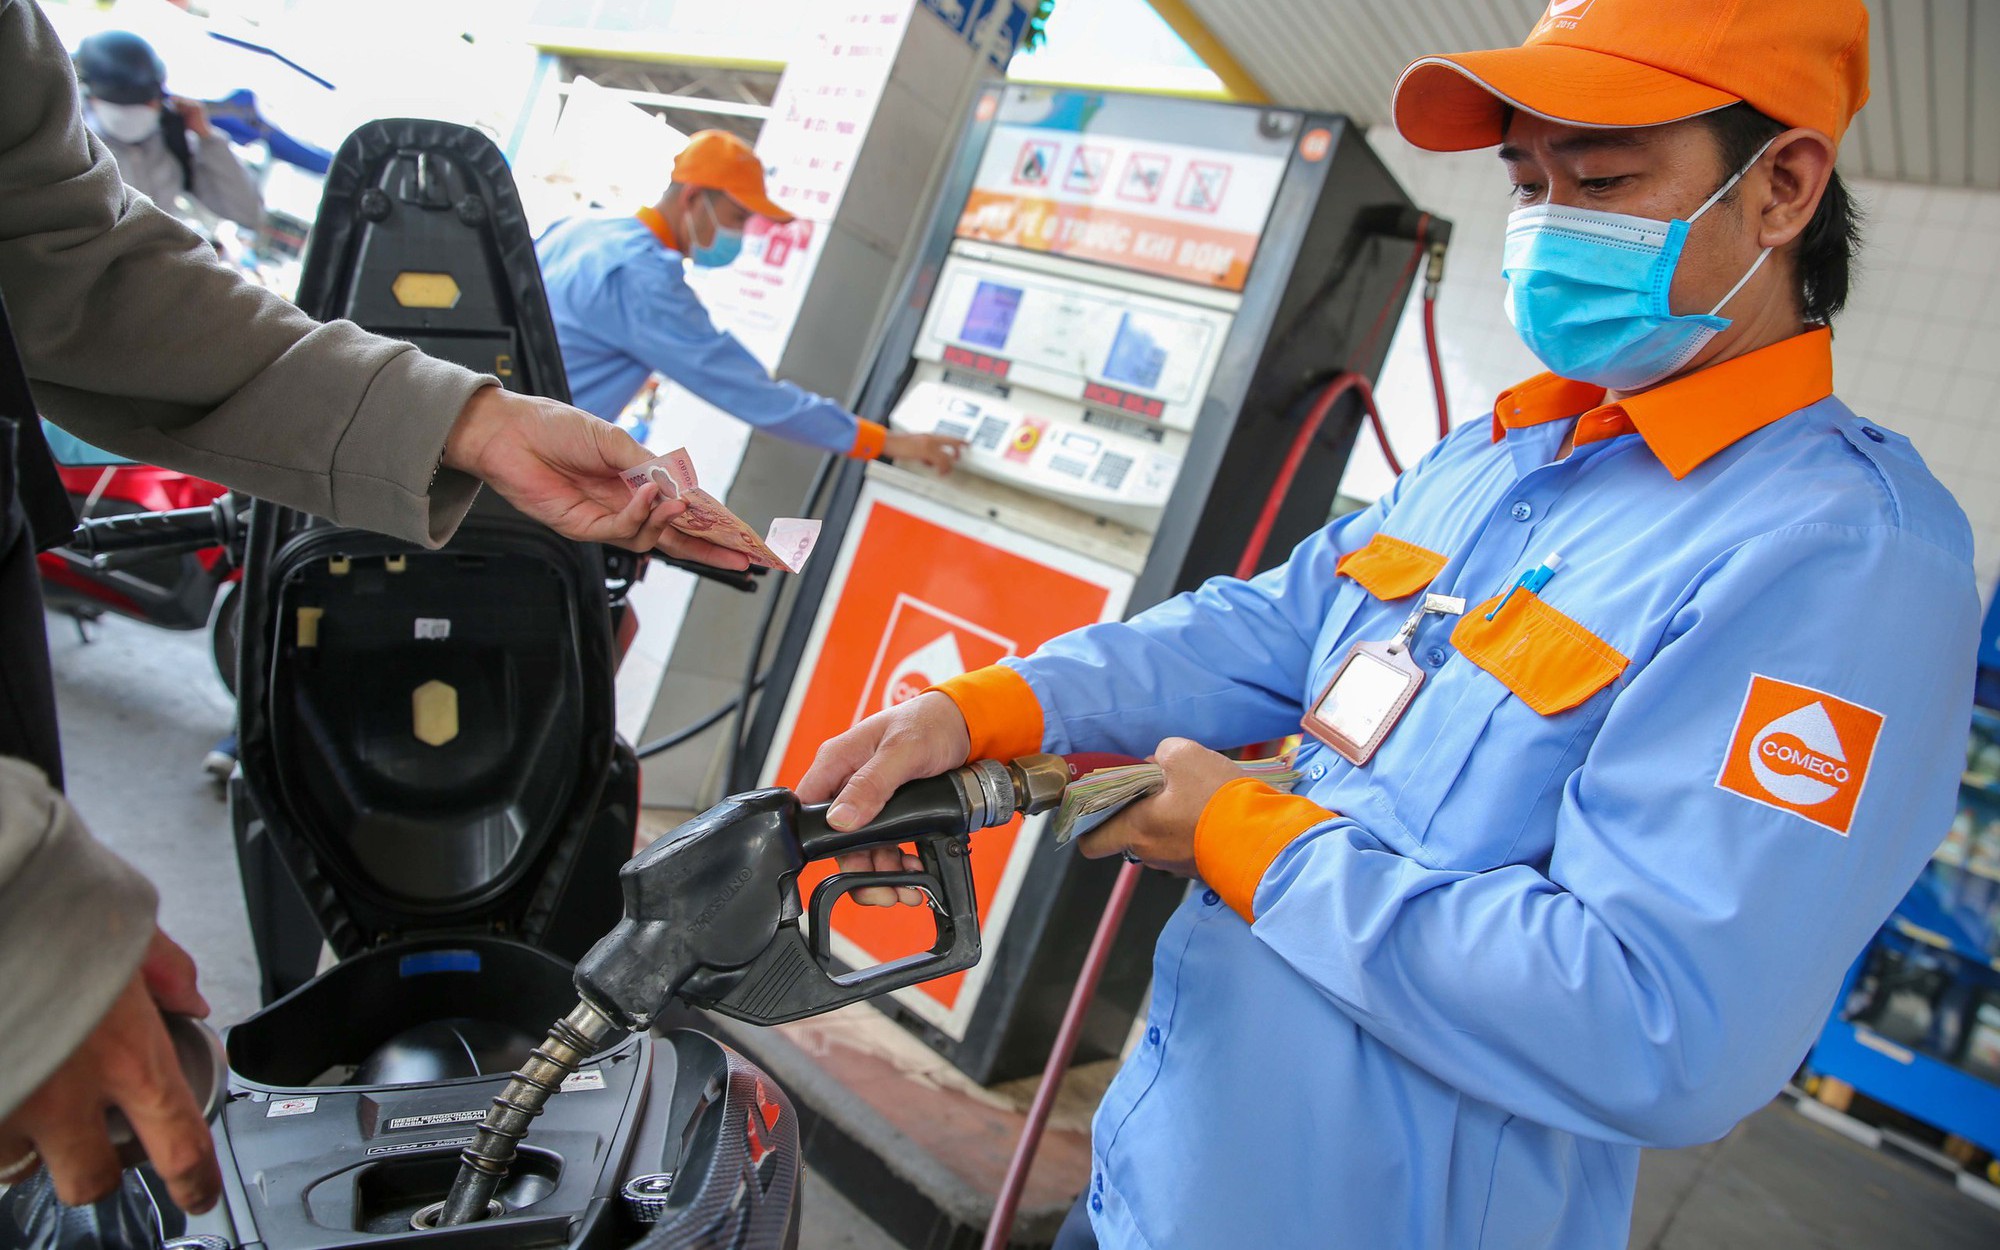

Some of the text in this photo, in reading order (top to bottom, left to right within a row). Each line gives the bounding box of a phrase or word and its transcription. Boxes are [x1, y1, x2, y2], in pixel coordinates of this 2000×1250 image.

[1555, 20, 1578, 30] 2015
[1133, 230, 1175, 261] KHI
[1762, 740, 1851, 784] COMECO
[373, 1144, 418, 1153] AHM
